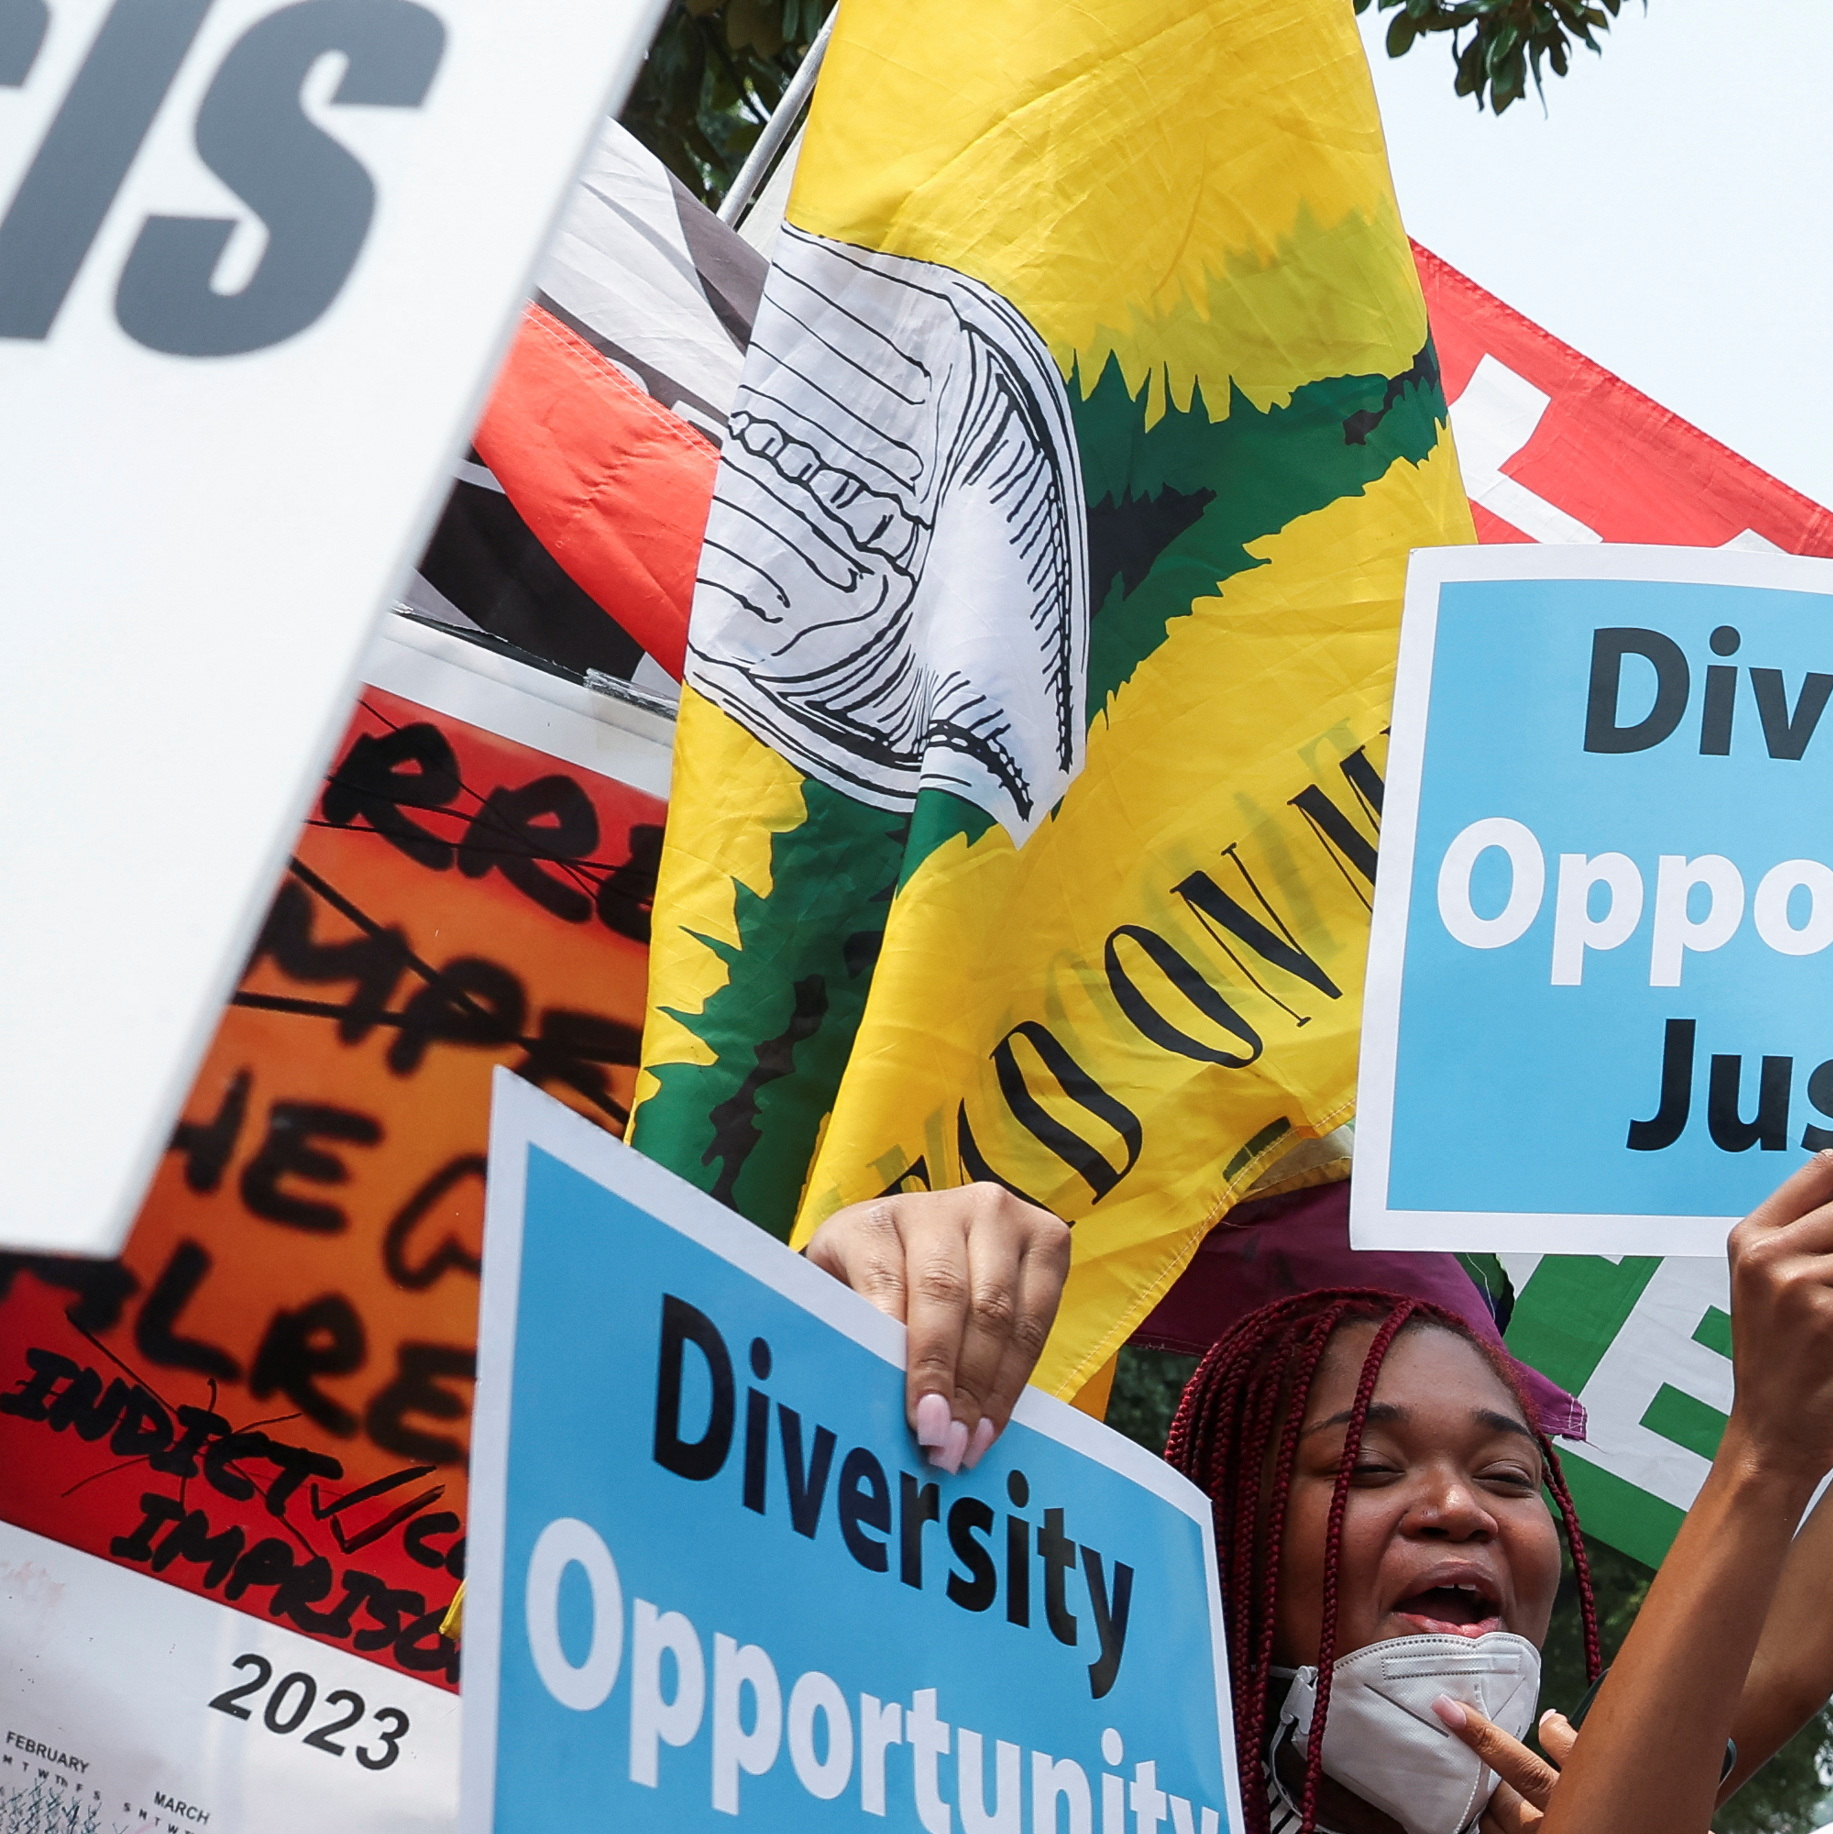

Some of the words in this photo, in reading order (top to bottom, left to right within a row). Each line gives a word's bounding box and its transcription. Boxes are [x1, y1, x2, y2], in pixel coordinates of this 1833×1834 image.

[0, 0, 447, 359] IS
[0, 1347, 344, 1517] INDICT
[651, 1293, 1135, 1700] Diversity
[6, 1730, 90, 1774] FEBRUARY
[208, 1653, 411, 1771] 2023
[153, 1791, 211, 1826] MARCH
